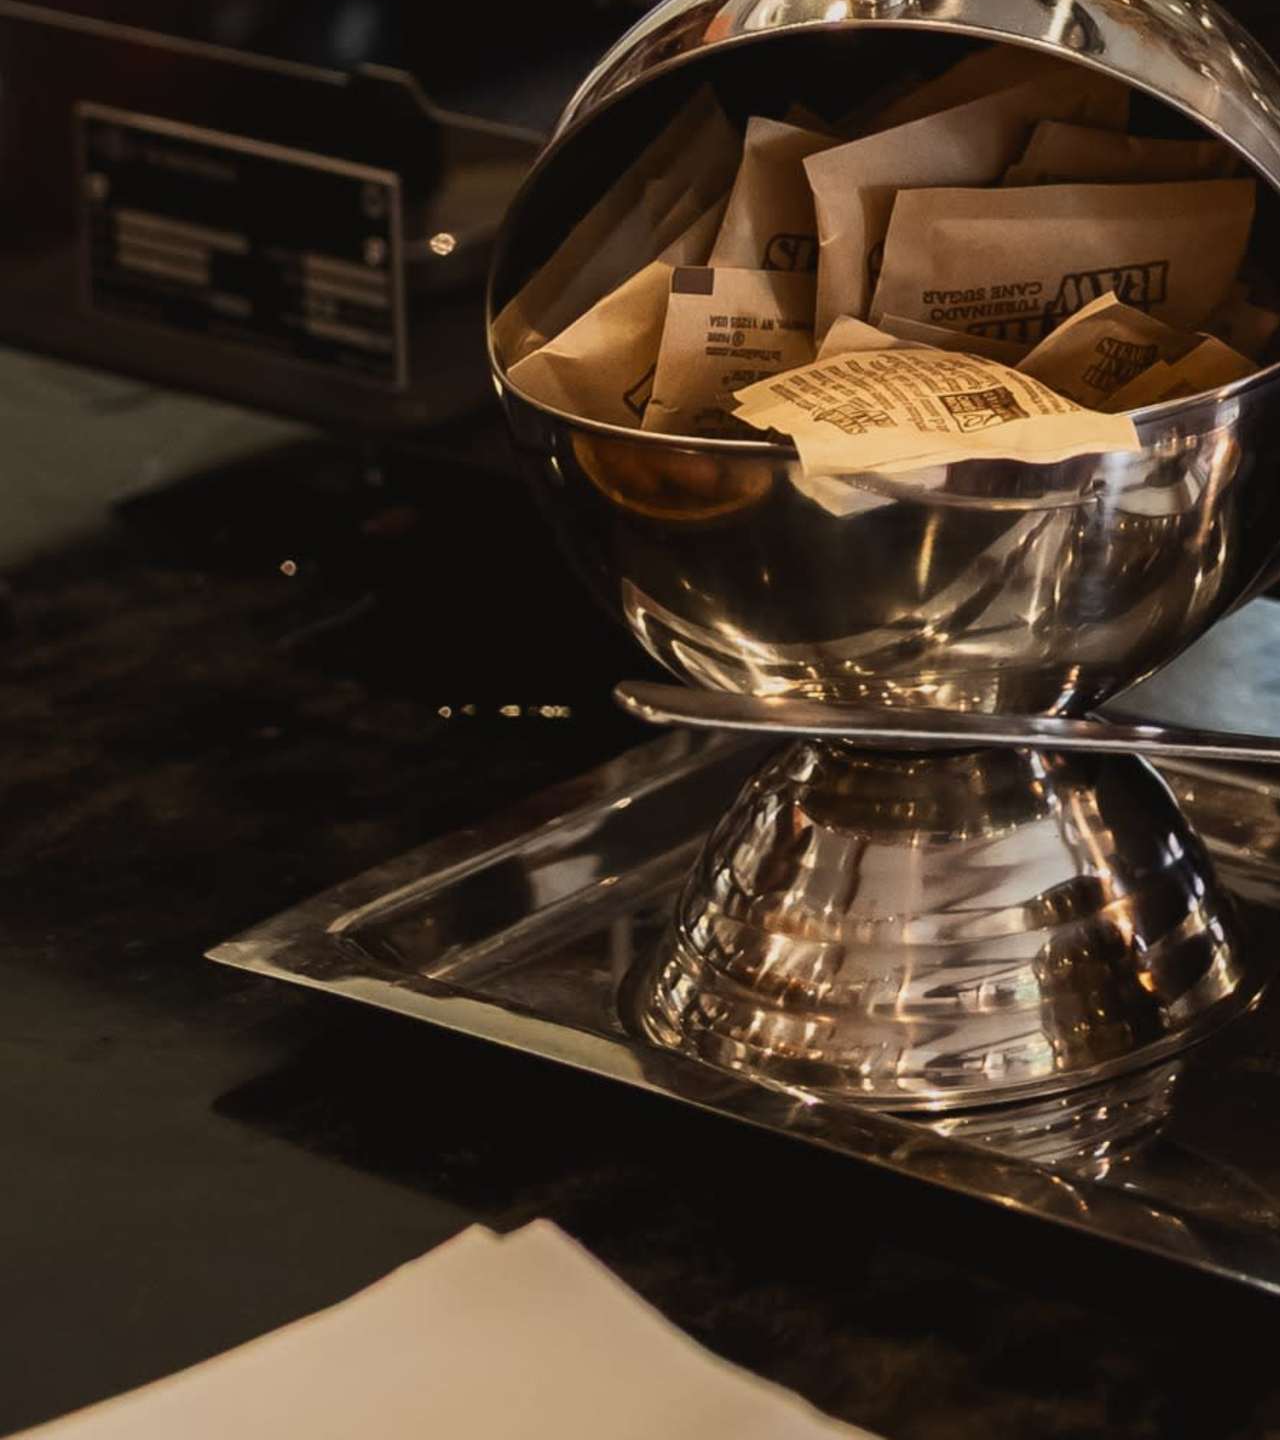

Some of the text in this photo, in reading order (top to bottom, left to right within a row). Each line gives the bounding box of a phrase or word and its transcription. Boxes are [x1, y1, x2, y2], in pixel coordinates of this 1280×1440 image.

[922, 281, 1043, 305] CANE SUGAR
[930, 297, 1041, 321] TURBINADO
[709, 315, 728, 328] USA
